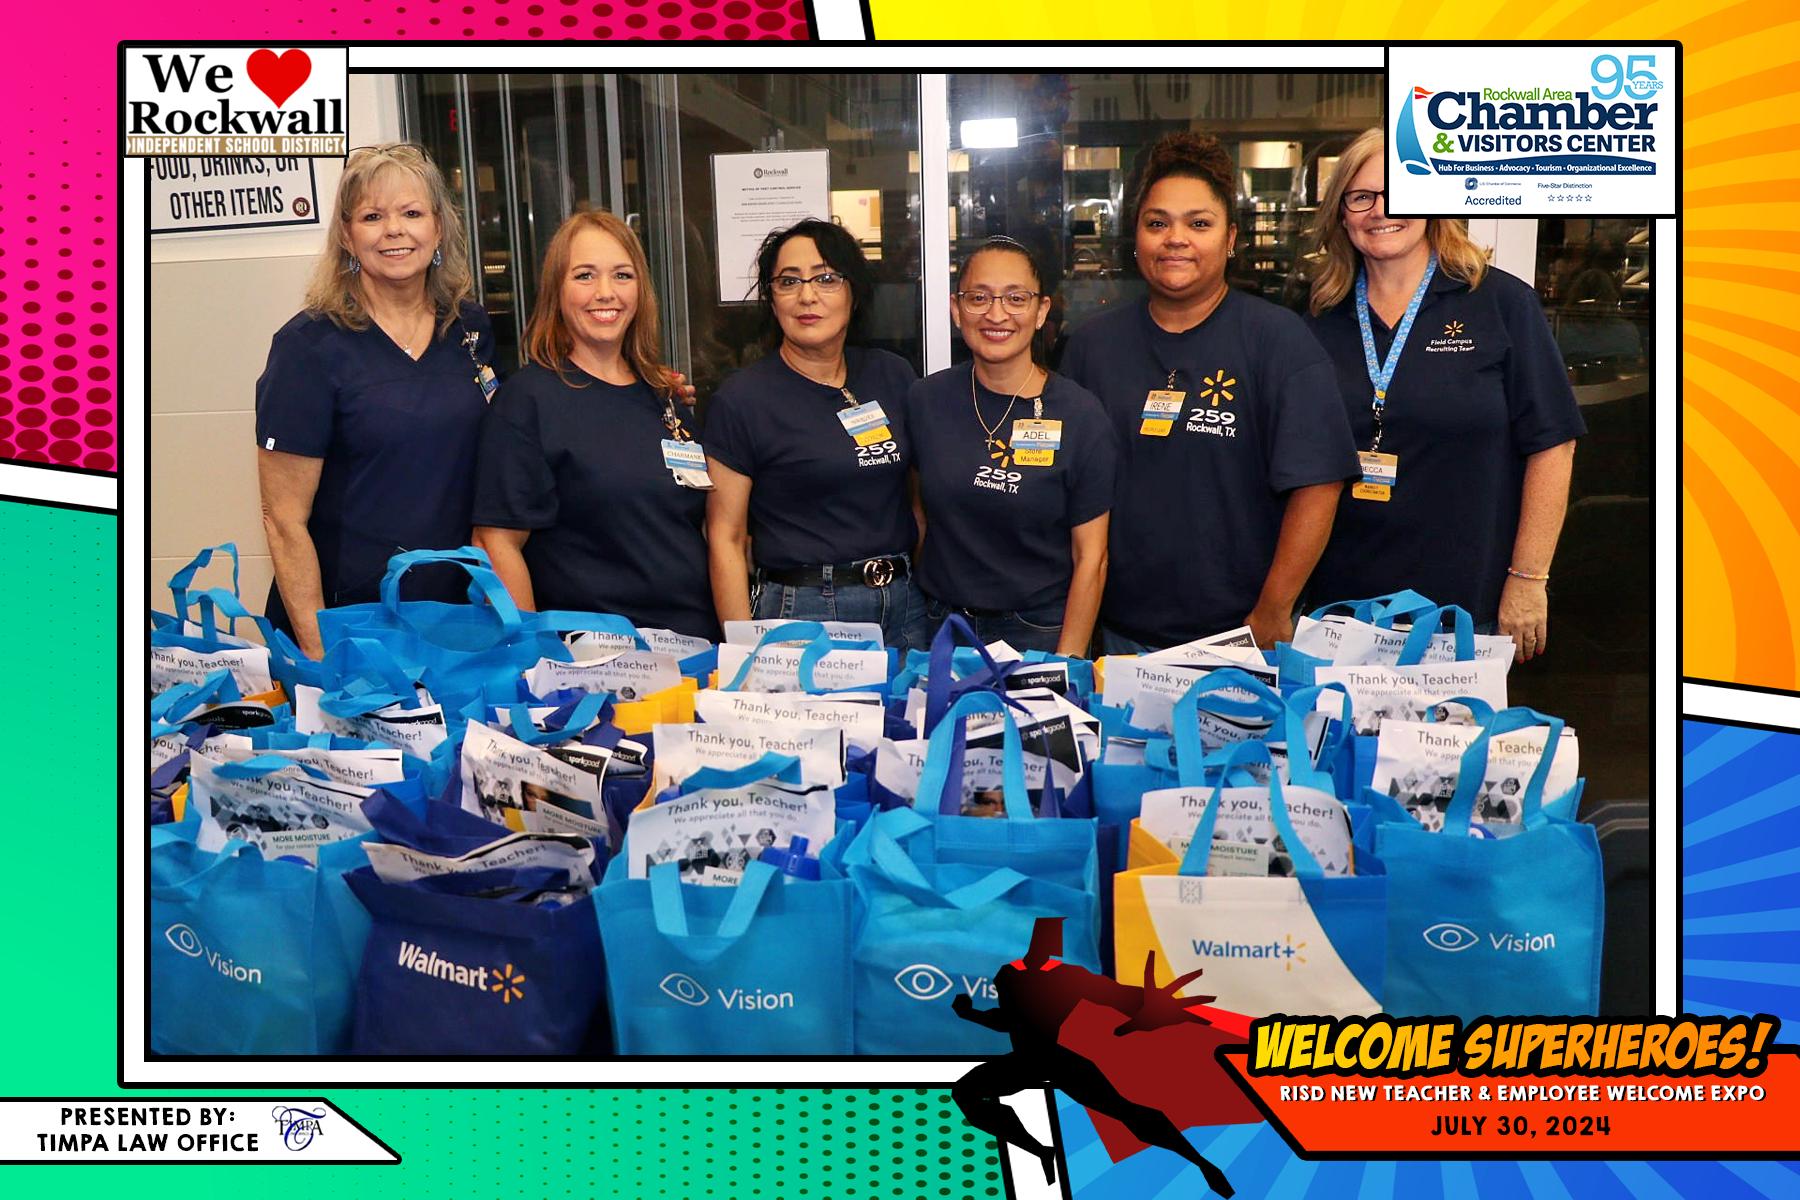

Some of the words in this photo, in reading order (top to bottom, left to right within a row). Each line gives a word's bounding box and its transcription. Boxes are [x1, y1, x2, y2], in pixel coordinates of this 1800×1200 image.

[151, 157, 196, 182] OOD,
[200, 157, 271, 177] DRINKS,
[170, 189, 227, 220] OTHER
[230, 186, 284, 216] ITEMS
[1189, 408, 1235, 425] 259
[1023, 431, 1050, 440] ADEL
[1186, 422, 1223, 436] Rockwall,
[1225, 427, 1236, 437] TX
[855, 441, 897, 457] 259
[858, 455, 892, 467] Rockwall,
[892, 453, 901, 462] TX
[976, 466, 1022, 482] 259
[974, 477, 1006, 493] Rockwall,
[1008, 484, 1019, 494] TX
[652, 634, 695, 648] Teacher!
[828, 631, 863, 641] acher!
[178, 659, 198, 668] you,
[198, 658, 244, 670] Teacher!
[612, 659, 658, 672] Teacher!
[815, 659, 864, 671] Teacher!
[1027, 675, 1062, 684] sparkgood
[1135, 667, 1172, 684] Thank
[1348, 673, 1387, 685] Thank
[1392, 675, 1419, 688] you,
[1422, 673, 1478, 685] Teacher!
[1370, 688, 1412, 697] appreciate
[1442, 689, 1456, 697] you
[733, 699, 771, 715] Thank
[774, 707, 800, 719] you,
[805, 709, 859, 723] Teacher!
[376, 721, 422, 741] Teacher!
[1214, 724, 1240, 740] you,
[688, 730, 725, 745] Thank
[729, 736, 755, 749] you,
[759, 736, 814, 751] Teacher!
[1418, 731, 1460, 748] Thank
[1497, 741, 1543, 755] Teache
[510, 753, 534, 767] you,
[708, 750, 746, 759] appreciate
[1425, 749, 1437, 757] We
[568, 756, 600, 767] sparkgood
[1499, 758, 1515, 767] that
[1518, 759, 1531, 768] you
[324, 759, 373, 781] Teacher!
[267, 779, 295, 794] you,
[298, 785, 353, 813] Teacher!
[667, 797, 708, 816] Thank
[713, 797, 743, 811] you,
[748, 792, 808, 814] Teacher!
[543, 808, 563, 819] MORE
[689, 813, 734, 824] appreciate
[749, 808, 767, 817] that
[769, 812, 784, 821] you
[1231, 799, 1262, 811] you,
[1268, 798, 1333, 820] acher!
[272, 835, 293, 843] MORE
[295, 834, 330, 842] MOISTURE
[400, 852, 441, 870] Thank
[480, 844, 546, 869] Teacher!
[1210, 845, 1258, 855] MOISTURE
[713, 873, 738, 884] MORE
[1192, 939, 1296, 959] Walmart+
[1489, 932, 1555, 952] Vision
[205, 946, 262, 984] Vision
[398, 941, 488, 991] Walmart
[962, 975, 999, 999] Vis
[718, 988, 794, 1010] Vision
